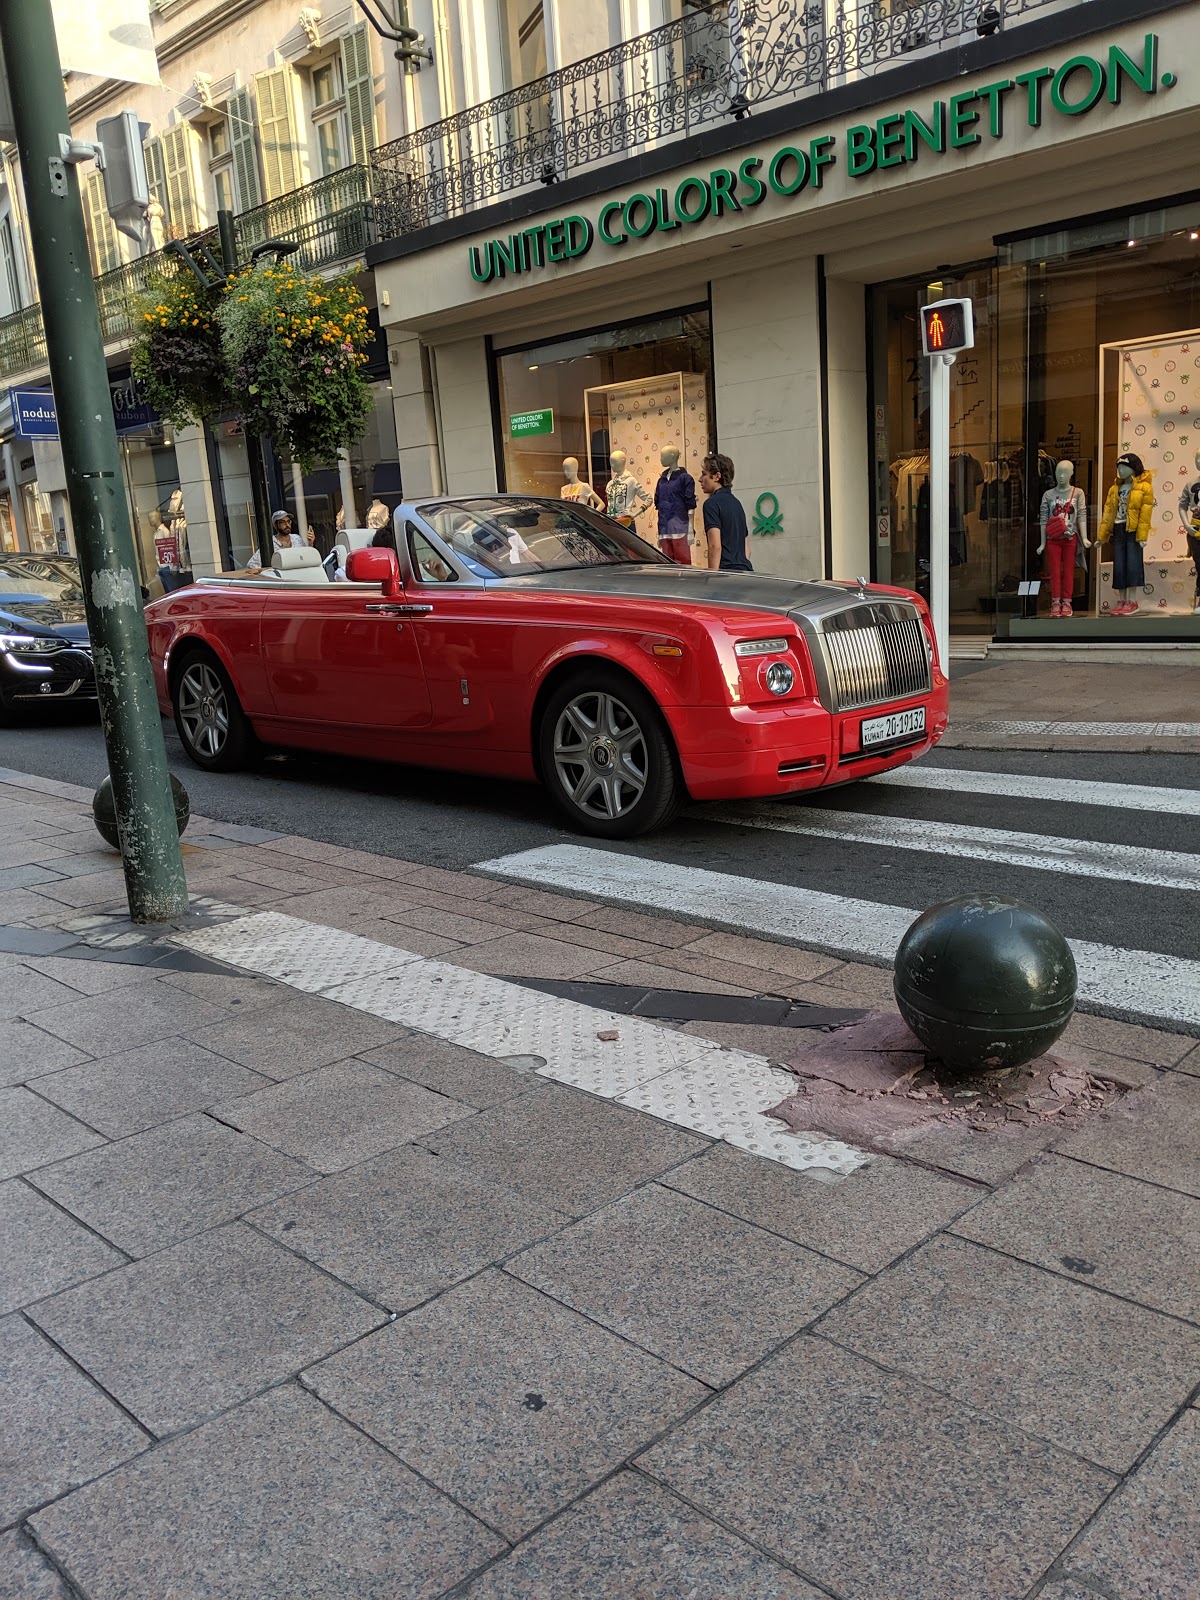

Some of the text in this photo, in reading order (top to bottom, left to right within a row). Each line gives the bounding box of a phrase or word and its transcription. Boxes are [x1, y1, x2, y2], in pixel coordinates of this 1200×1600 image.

[469, 35, 1177, 283] UNITED COLORS OF BENETTON.
[22, 407, 56, 418] nodus
[527, 414, 543, 422] COLORS
[864, 730, 884, 743] KUWAIT
